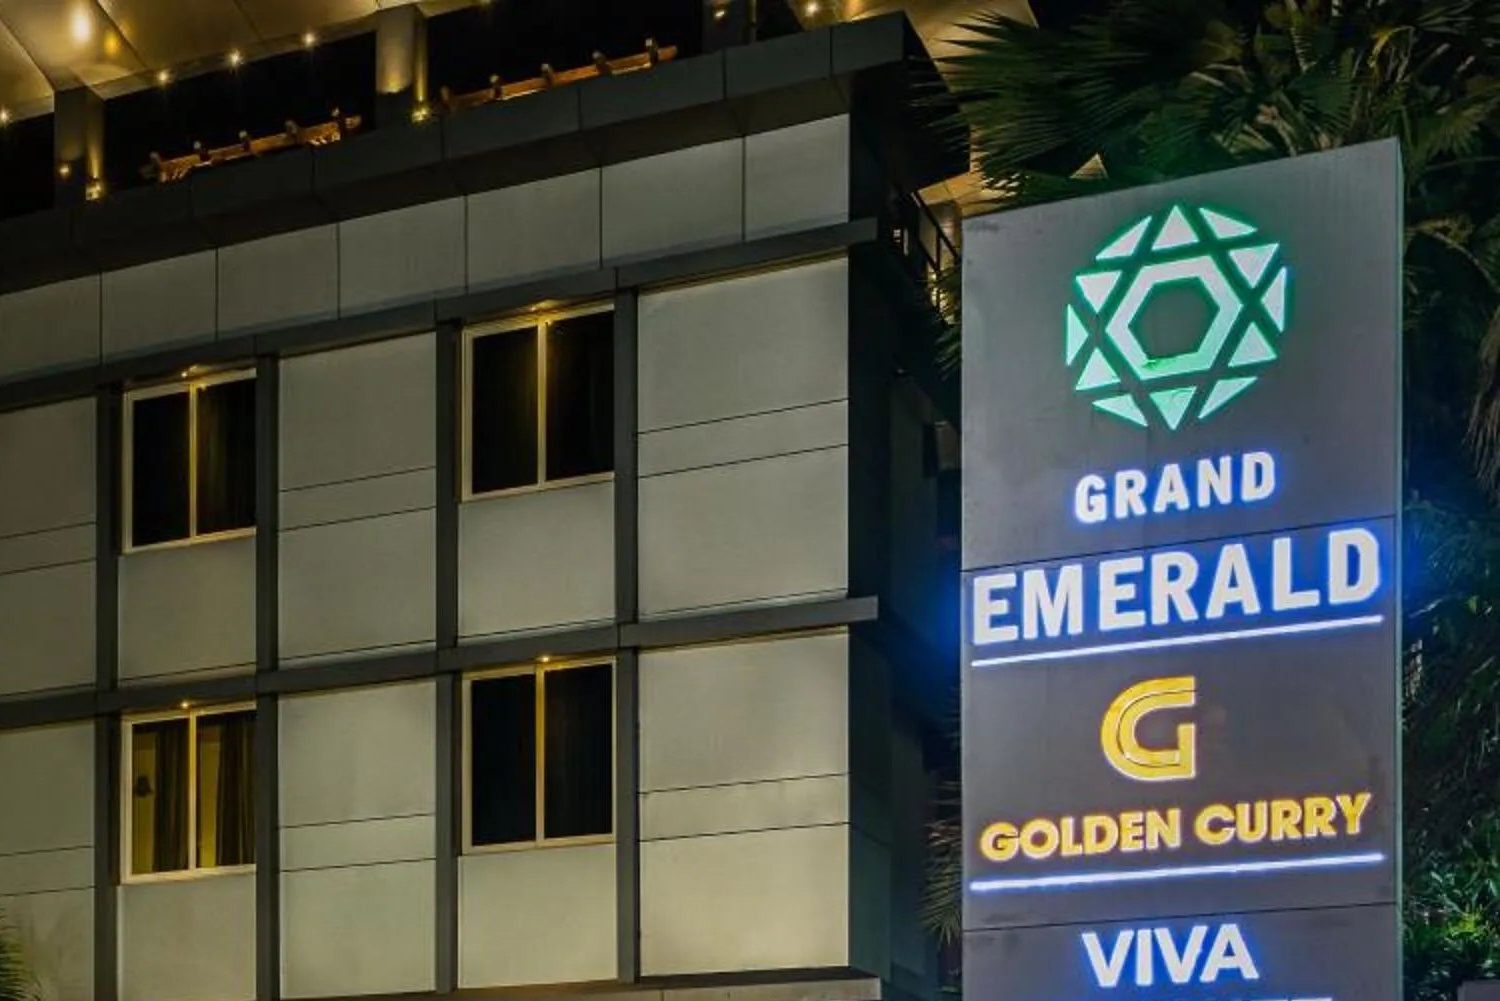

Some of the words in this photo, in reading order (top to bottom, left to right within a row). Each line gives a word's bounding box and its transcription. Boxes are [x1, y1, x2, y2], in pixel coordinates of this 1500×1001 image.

[1075, 451, 1276, 524] GRAND
[972, 528, 1381, 646] EMERALD
[980, 809, 1181, 861] GOLDEN
[1195, 793, 1372, 846] CURRY
[1082, 924, 1259, 988] VIVA
